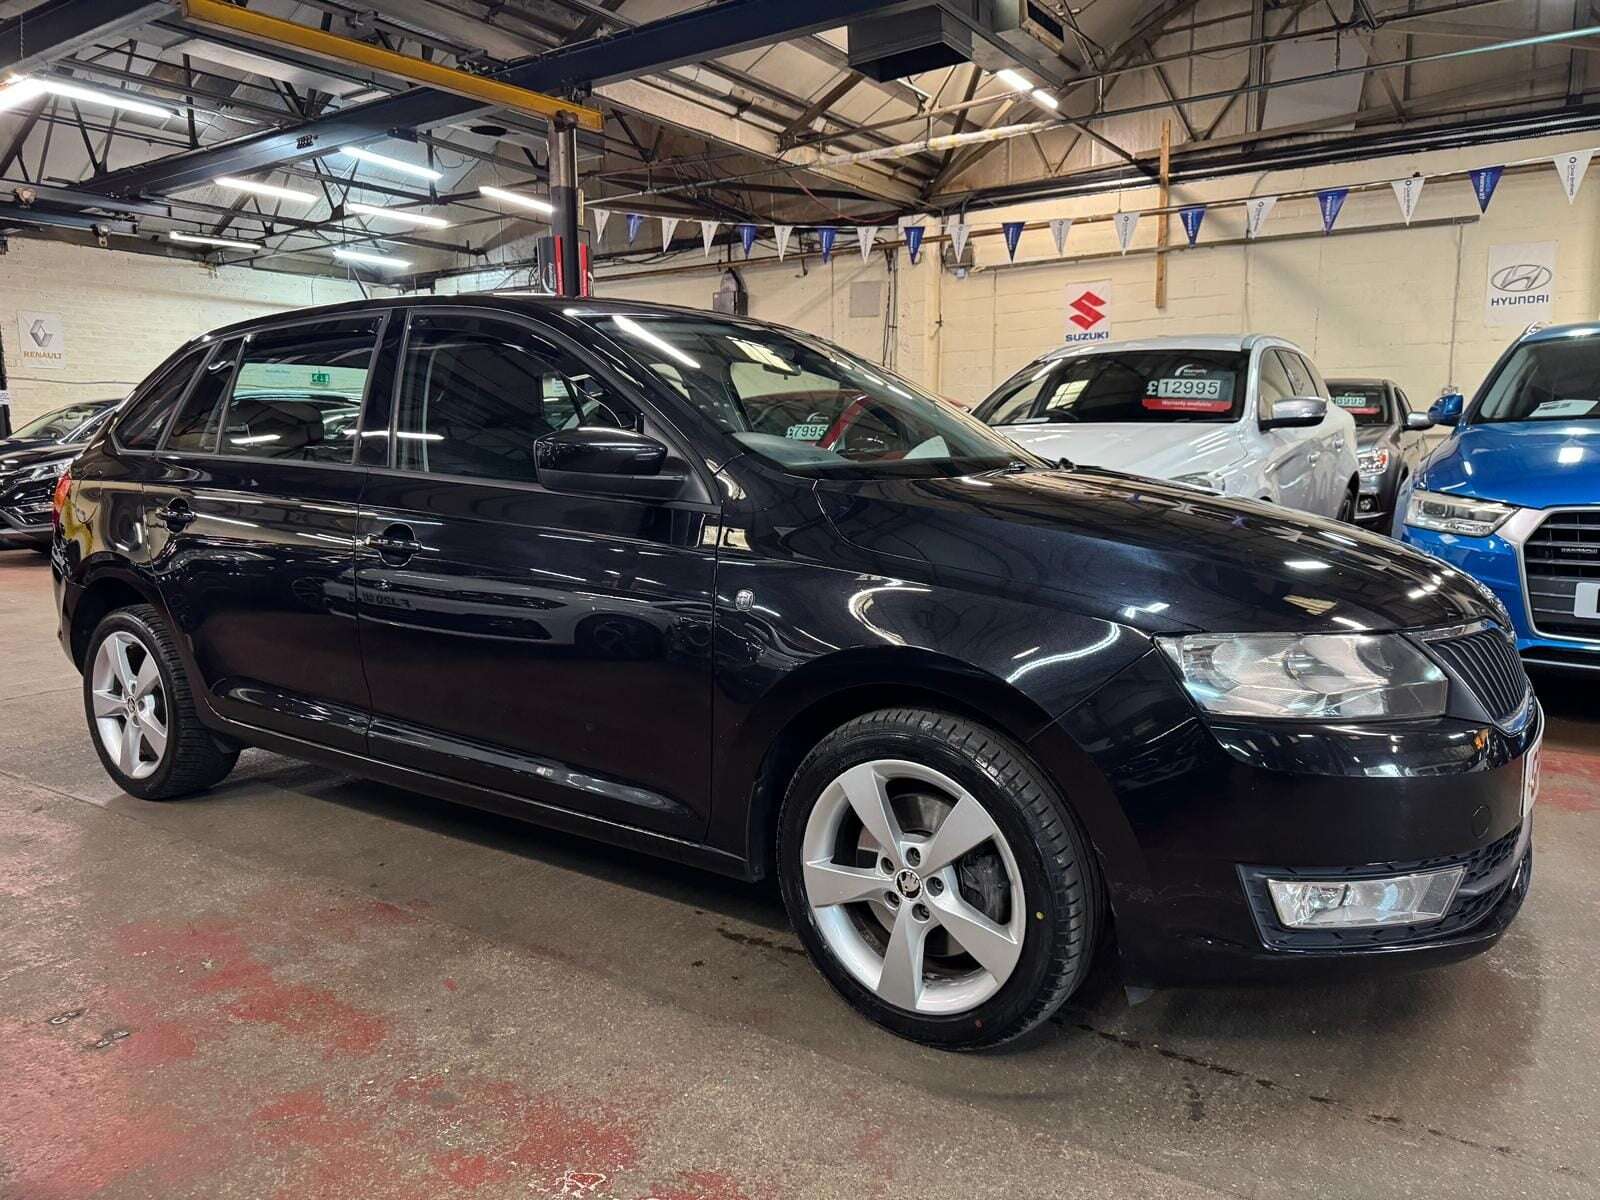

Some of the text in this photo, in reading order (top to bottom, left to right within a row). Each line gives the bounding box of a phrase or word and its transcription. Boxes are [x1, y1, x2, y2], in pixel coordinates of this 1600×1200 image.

[1491, 295, 1549, 306] HYUNDAI
[1065, 331, 1109, 342] SUZUKI
[23, 351, 62, 360] RENAULT
[1145, 380, 1219, 396] £12995
